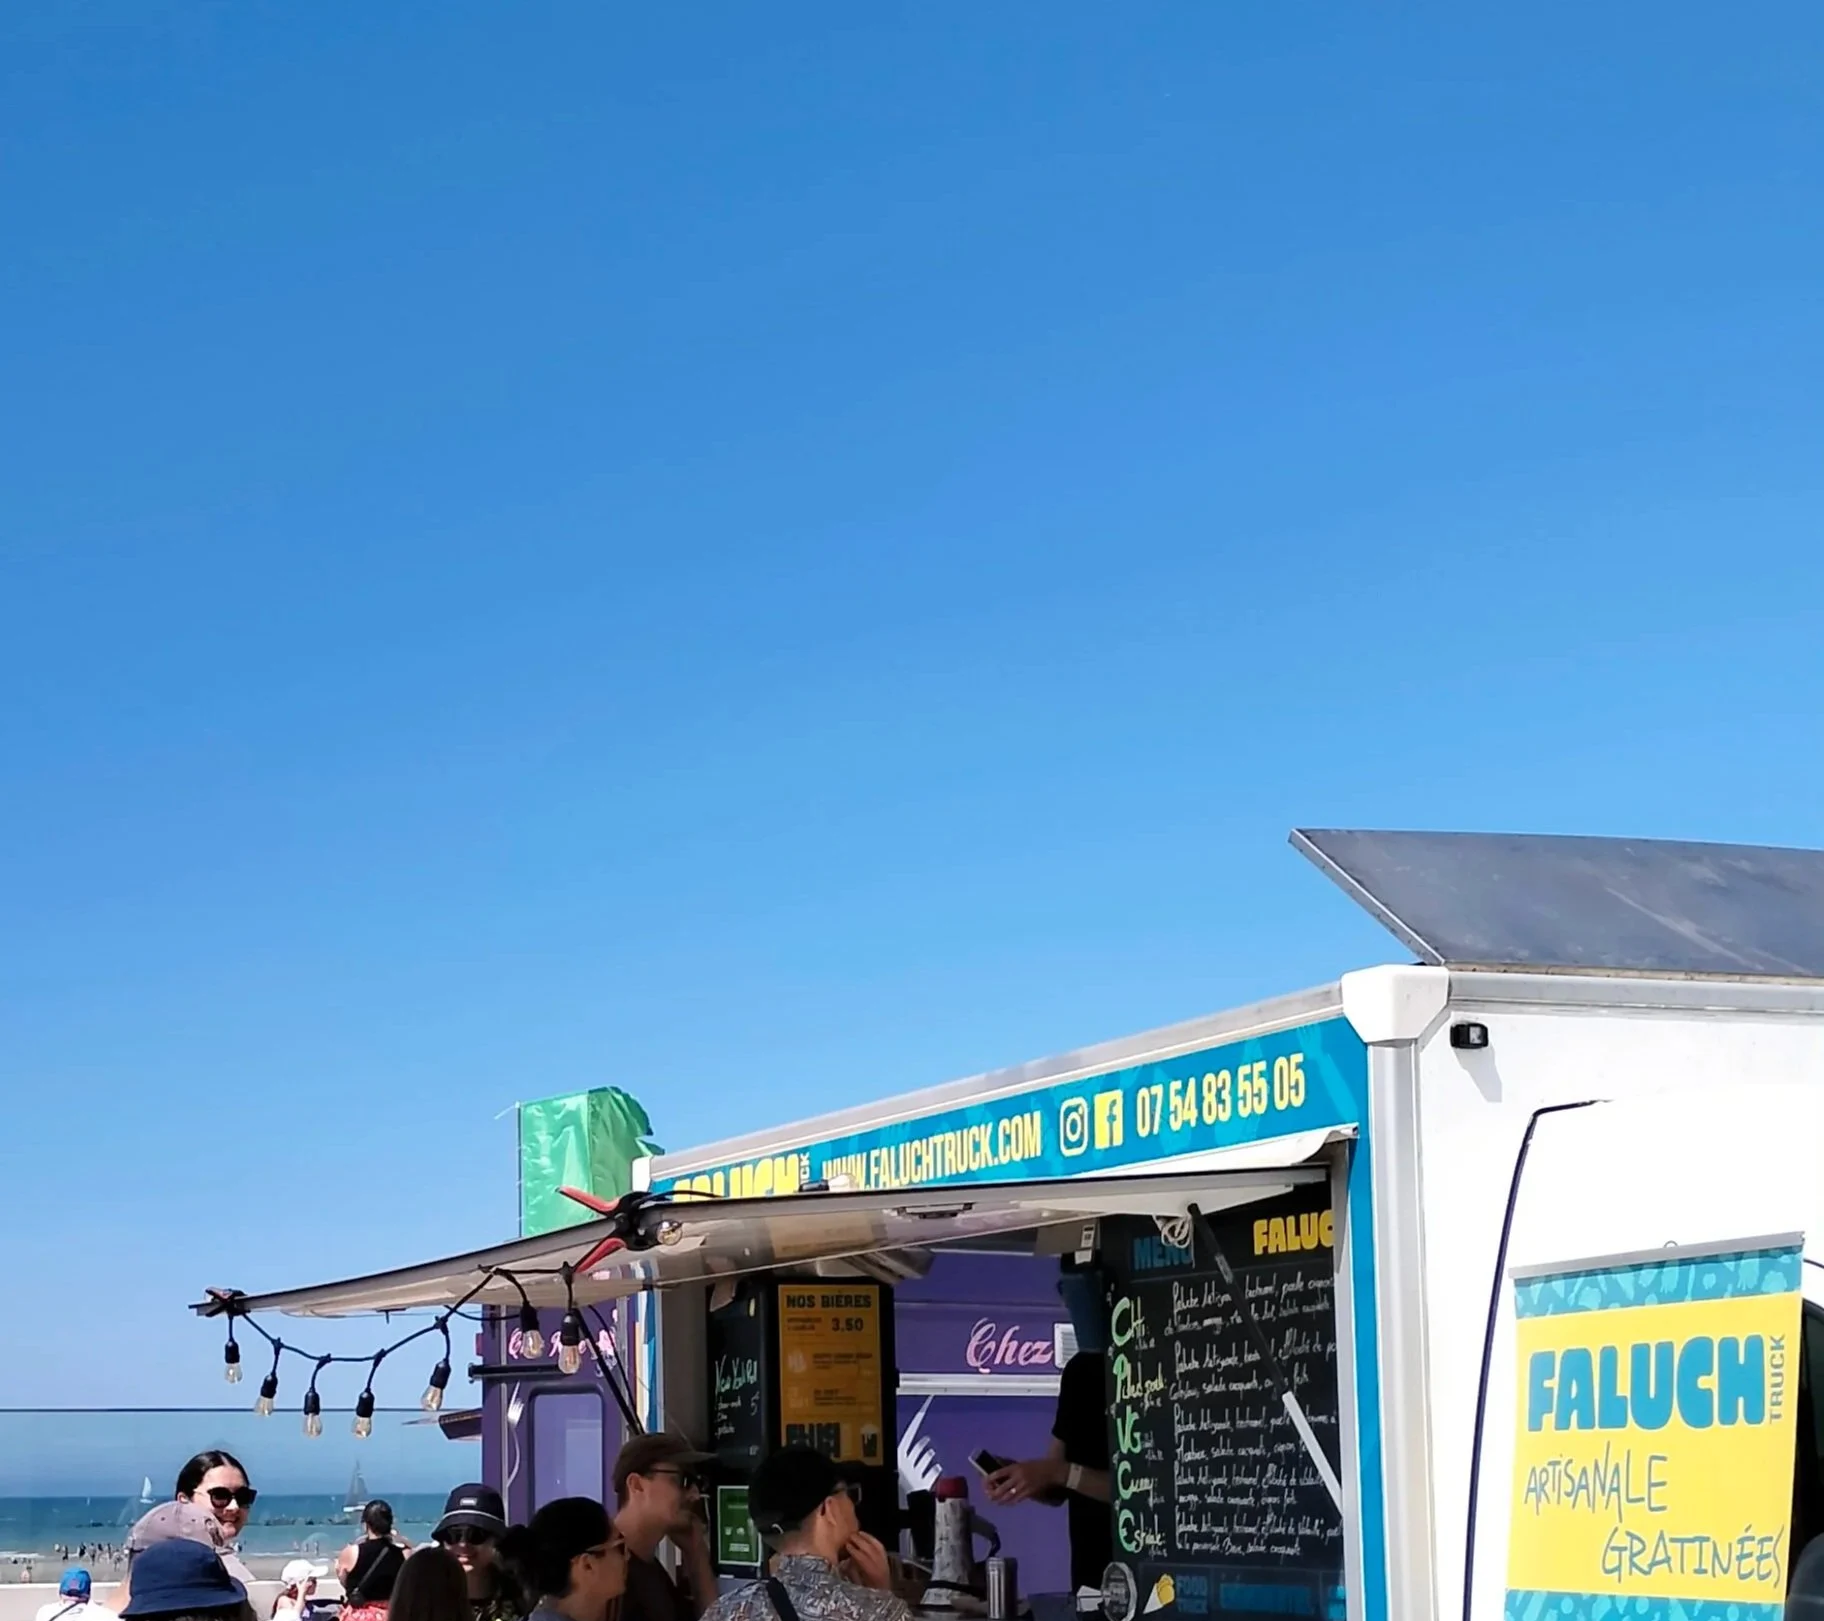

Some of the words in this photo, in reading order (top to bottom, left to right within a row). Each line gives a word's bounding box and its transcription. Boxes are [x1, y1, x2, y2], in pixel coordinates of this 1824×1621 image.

[1136, 1083, 1164, 1138] 07
[1169, 1076, 1198, 1132] 54
[1202, 1069, 1232, 1126] 83
[1237, 1060, 1268, 1118] 55
[1273, 1052, 1306, 1111] 05
[786, 1294, 816, 1309] NOS
[831, 1316, 864, 1332] 3.50
[966, 1317, 1054, 1373] Chez
[1527, 1334, 1766, 1433] FALUCH
[1769, 1334, 1786, 1425] TRUCK
[1601, 1524, 1785, 1589] GRATINÉES
